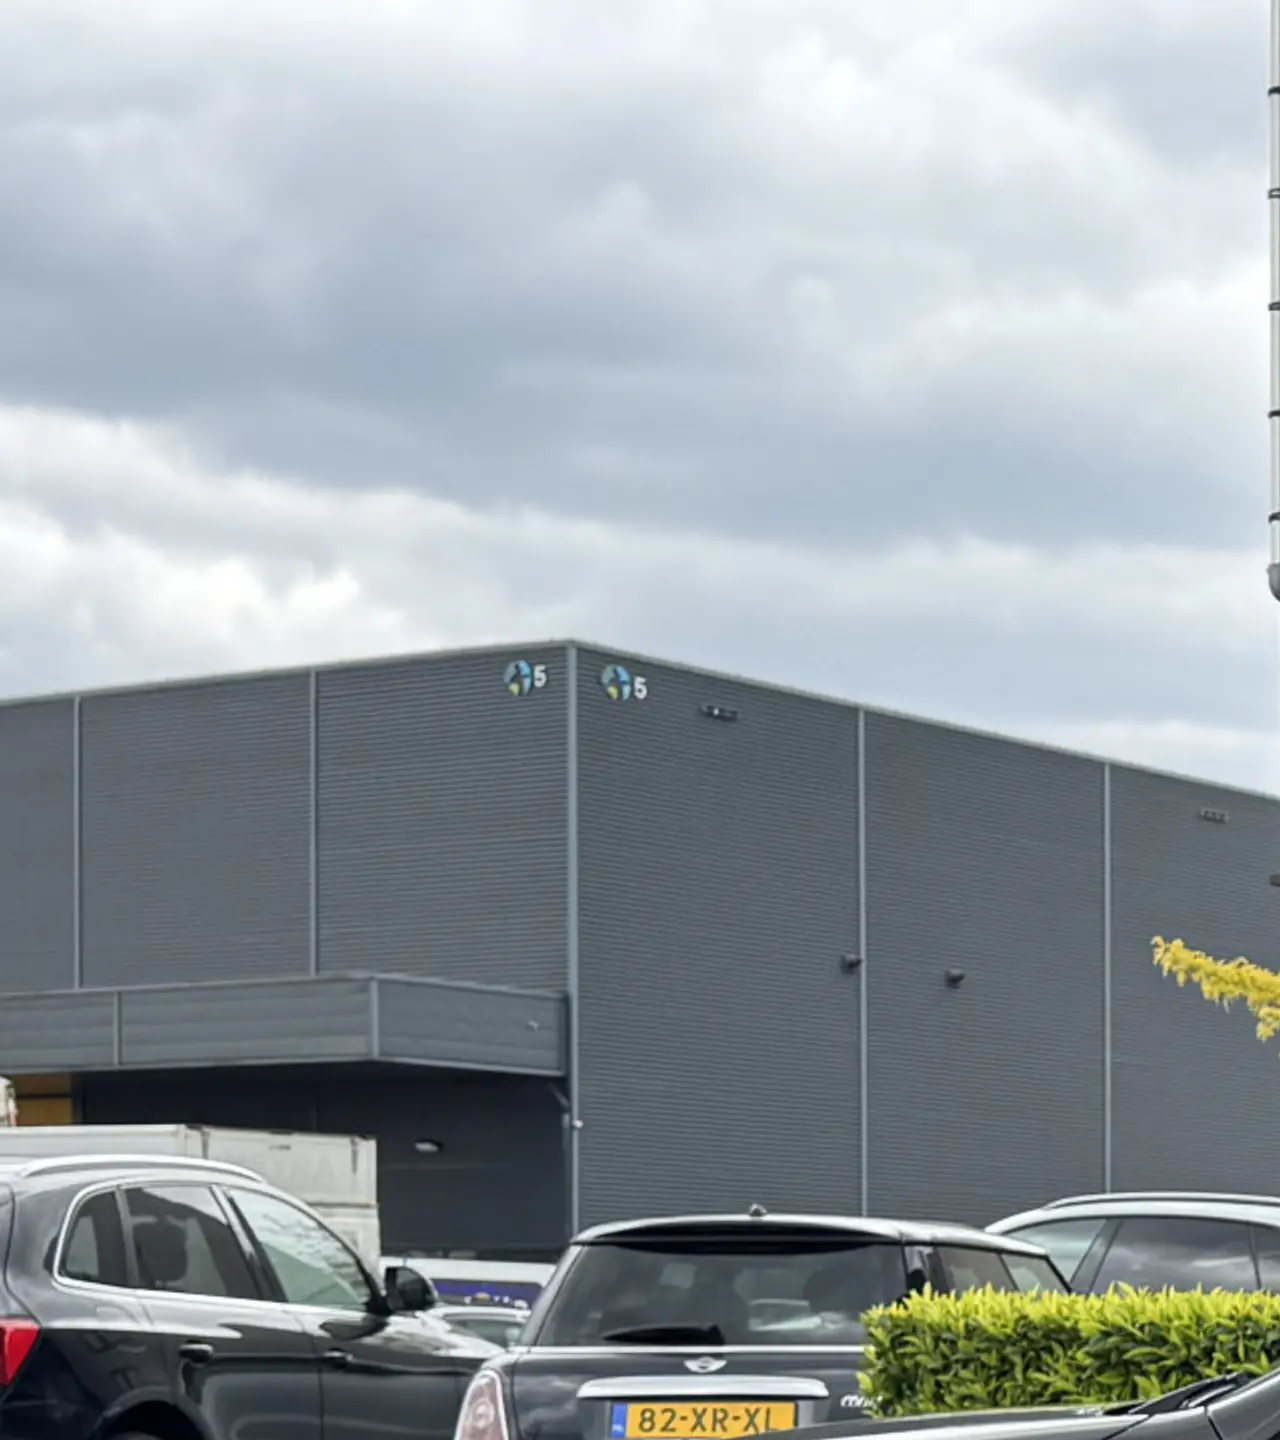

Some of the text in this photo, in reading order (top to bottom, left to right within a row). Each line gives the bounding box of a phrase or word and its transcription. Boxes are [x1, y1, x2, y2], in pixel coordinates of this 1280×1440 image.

[533, 664, 548, 688] 5
[634, 676, 649, 701] 5
[637, 1407, 778, 1433] 82-XR-XL
